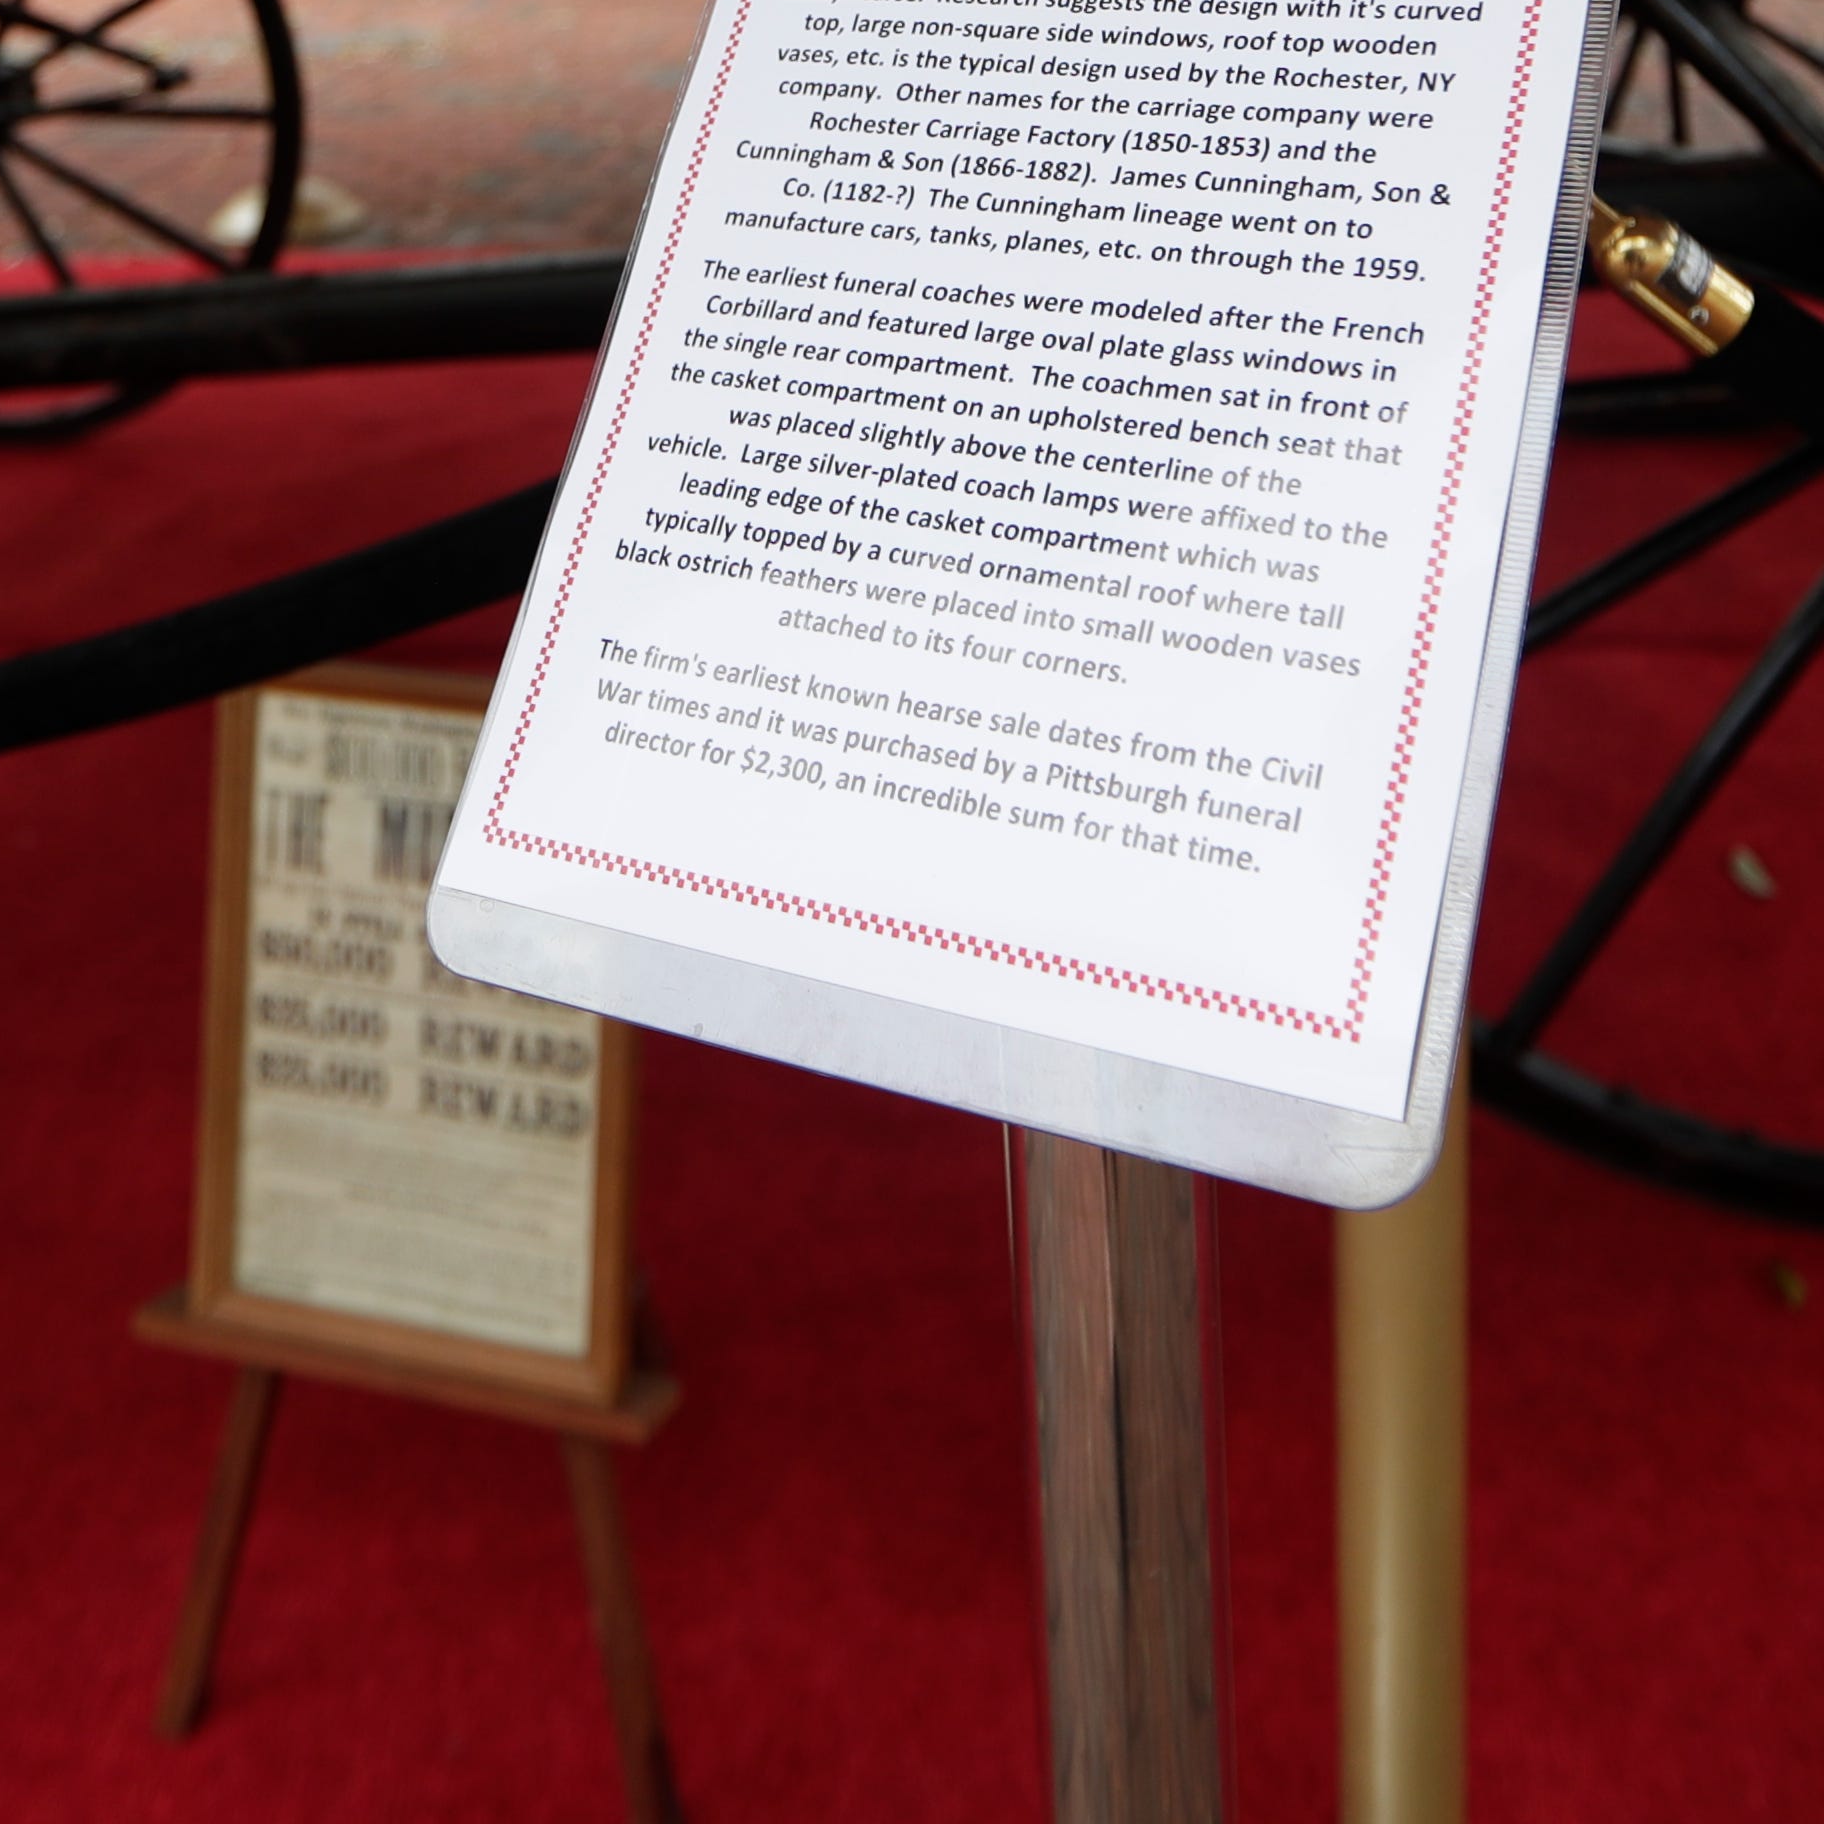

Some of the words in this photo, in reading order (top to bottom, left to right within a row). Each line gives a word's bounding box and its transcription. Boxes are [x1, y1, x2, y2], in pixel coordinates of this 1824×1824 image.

[804, 13, 845, 37] top,
[851, 12, 906, 39] large
[910, 20, 1041, 44] non-square
[1045, 22, 1094, 44] side
[1100, 25, 1215, 54] windows,
[1222, 29, 1279, 52] roof
[1281, 33, 1325, 58] top
[1332, 33, 1438, 57] wooden
[1393, 0, 1485, 23] curved
[777, 47, 839, 69] vases,
[845, 47, 885, 67] etc.
[891, 47, 910, 68] is
[915, 48, 953, 71] the
[958, 52, 1037, 77] typical
[1040, 55, 1117, 83] design
[1123, 60, 1183, 83] used
[1187, 61, 1220, 89] by
[1224, 63, 1267, 86] the
[1272, 66, 1409, 95] Rochester,
[1416, 71, 1457, 93] NY
[778, 79, 883, 105] company.
[895, 82, 963, 105] Other
[966, 90, 1044, 110] names
[1049, 89, 1086, 112] for
[1091, 92, 1131, 115] the
[1136, 97, 1236, 125] carriage
[1242, 105, 1362, 132] company
[1367, 110, 1435, 130] were
[735, 139, 872, 169] Cunningham
[876, 148, 896, 171] &
[900, 151, 945, 173] Son
[950, 152, 1097, 189] (1866-1882).
[1109, 164, 1188, 190] James
[1194, 170, 1364, 206] Cunningham,
[1370, 180, 1422, 204] Son
[1429, 183, 1452, 207] &
[808, 110, 922, 137] Rochester
[925, 118, 1021, 148] Carriage
[1026, 124, 1117, 155] Factory
[1121, 128, 1271, 164] (1850-1853)
[1276, 139, 1328, 162] and
[1333, 140, 1378, 165] the
[782, 176, 816, 199] Co.
[822, 177, 916, 211] (1182-?)
[928, 187, 970, 211] The
[975, 191, 1126, 223] Cunningham
[1132, 201, 1224, 233] lineage
[1231, 213, 1299, 235] went
[1303, 219, 1338, 238] on
[1345, 218, 1374, 240] to
[723, 210, 865, 238] manufacture
[870, 223, 922, 247] cars,
[929, 224, 998, 254] tanks,
[1003, 229, 1091, 261] planes,
[1098, 239, 1143, 261] etc.
[1150, 245, 1183, 263] on
[1190, 242, 1294, 276] through
[1301, 251, 1346, 276] the
[1352, 256, 1427, 283] 1959.
[703, 258, 741, 282] The
[745, 265, 830, 291] earliest
[833, 270, 918, 299] funeral
[921, 283, 1017, 309] coaches
[1023, 293, 1085, 315] were
[1089, 297, 1204, 325] modeled
[1208, 305, 1275, 331] after
[1280, 310, 1325, 337] the
[1331, 316, 1425, 346] French
[705, 294, 816, 324] Corbillard
[817, 307, 864, 329] and
[866, 308, 971, 341] featured
[973, 319, 1036, 352] large
[1041, 330, 1096, 354] oval
[1098, 333, 1165, 361] plate
[1168, 339, 1235, 368] glass
[1242, 347, 1365, 380] windows
[1370, 357, 1398, 383] in
[683, 326, 719, 350] the
[722, 331, 788, 360] single
[791, 343, 842, 363] rear
[845, 349, 1015, 384] compartment.
[1031, 364, 1076, 390] The
[1081, 373, 1213, 405] coachmen
[1218, 387, 1261, 410] sat
[1266, 387, 1292, 413] in
[1300, 390, 1371, 421] front
[1376, 400, 1410, 425] of
[670, 360, 706, 385] the
[710, 367, 782, 394] casket
[785, 379, 948, 414] compartment
[952, 399, 984, 418] on
[989, 403, 1021, 423] an
[1027, 405, 1184, 441] upholstered
[1188, 418, 1270, 451] bench
[1276, 435, 1337, 459] seat
[1343, 437, 1403, 466] that
[729, 408, 773, 430] was
[775, 410, 856, 441] placed
[858, 420, 947, 457] slightly
[950, 432, 1027, 463] above
[1033, 442, 1076, 469] the
[1082, 453, 1214, 486] centerline
[1220, 465, 1253, 490] of
[1257, 468, 1303, 496] the
[647, 432, 727, 462] vehicle.
[739, 442, 803, 475] Large
[806, 452, 960, 493] silver-plated
[963, 477, 1036, 504] coach
[1041, 481, 1121, 518] lamps
[1127, 498, 1194, 524] were
[1200, 503, 1297, 537] affixed
[1303, 517, 1333, 542] to
[1341, 520, 1389, 549] the
[604, 720, 697, 759] director
[700, 737, 736, 767] for
[739, 744, 827, 791] $2,300,
[834, 771, 867, 795] an
[872, 772, 1002, 821] incredible
[1007, 805, 1065, 834] sum
[1073, 810, 1115, 843] for
[1121, 822, 1181, 857] that
[1187, 835, 1261, 874] time.
